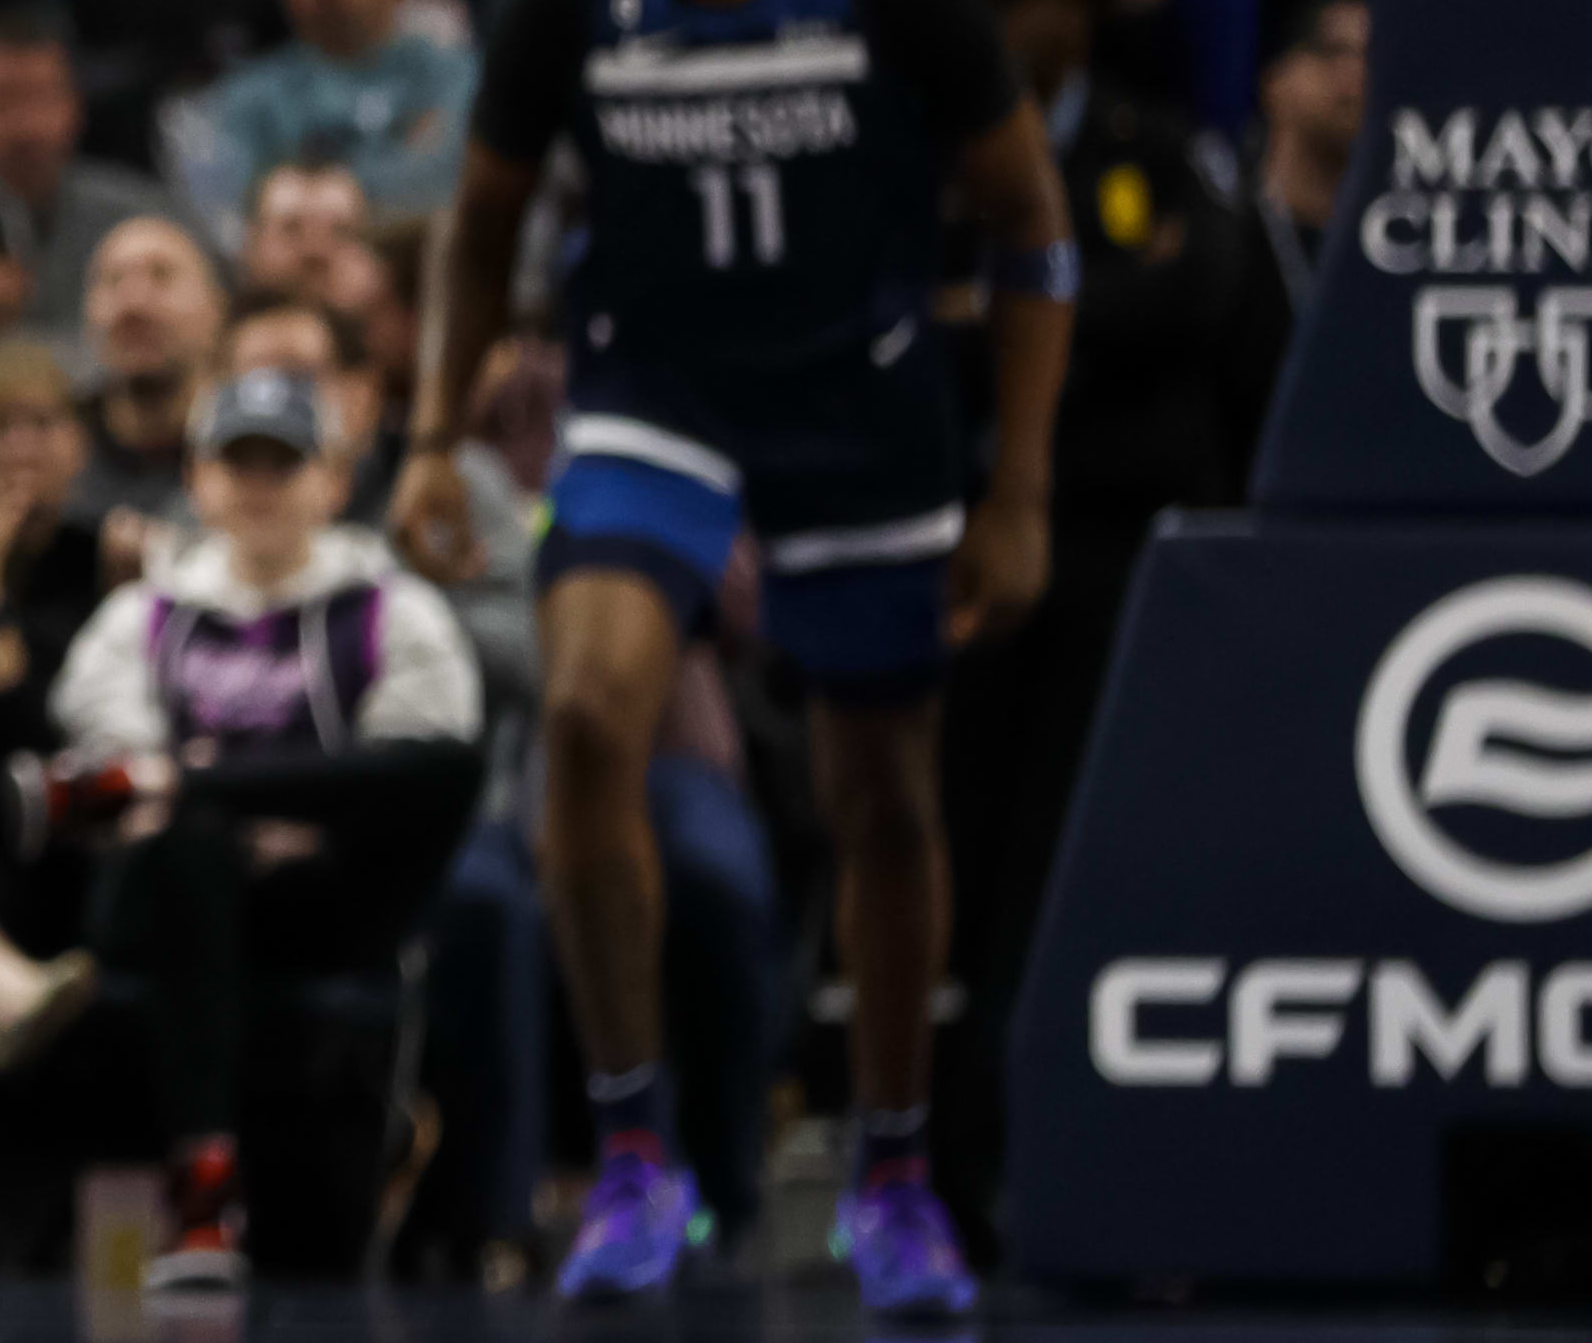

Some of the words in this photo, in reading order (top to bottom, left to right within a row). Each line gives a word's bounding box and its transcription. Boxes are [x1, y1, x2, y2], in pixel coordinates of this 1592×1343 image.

[594, 91, 859, 164] MINNESOTA
[1391, 106, 1592, 190] MAY
[687, 160, 789, 270] 11
[1359, 190, 1590, 276] CLIN
